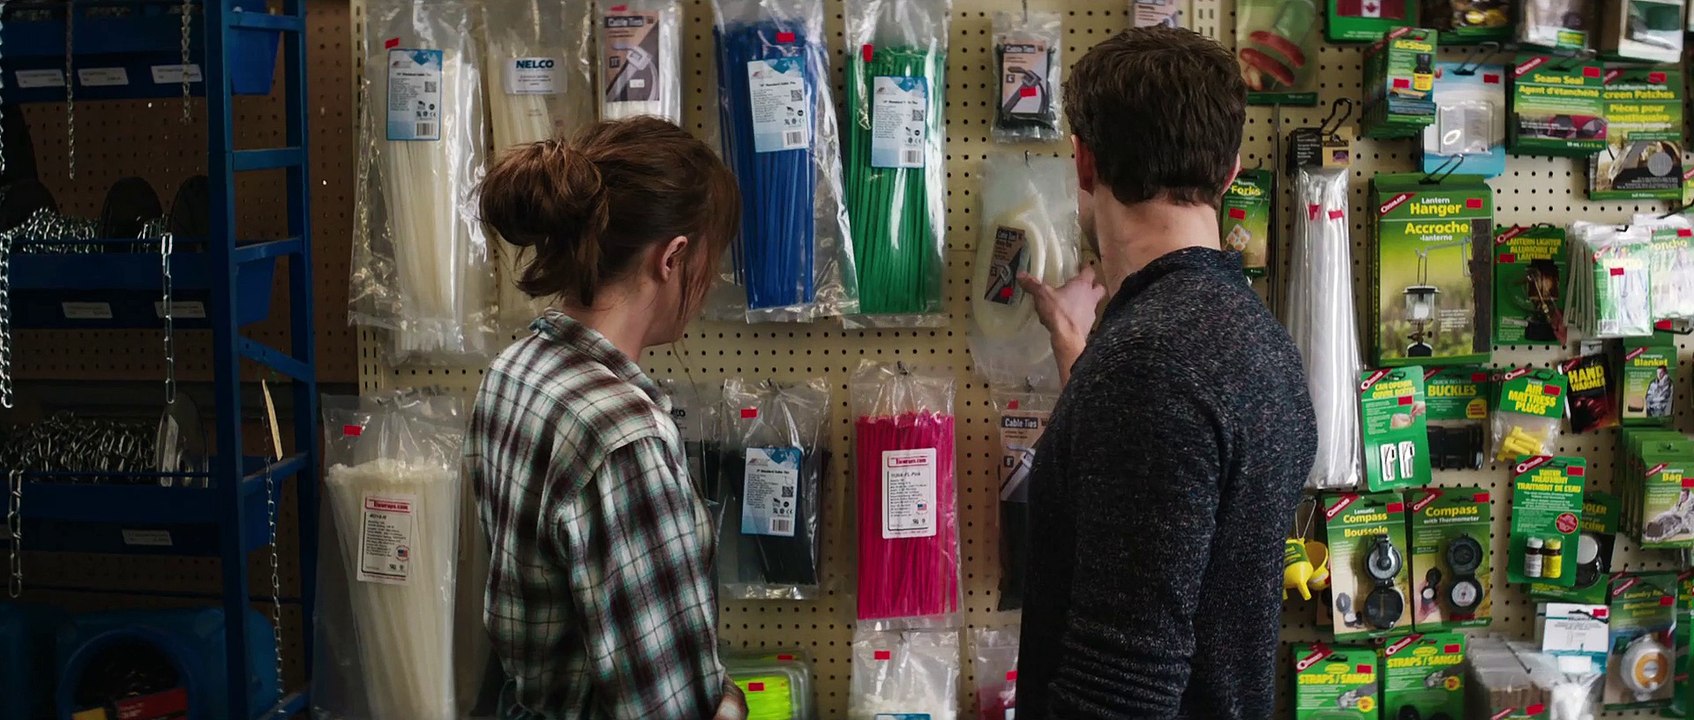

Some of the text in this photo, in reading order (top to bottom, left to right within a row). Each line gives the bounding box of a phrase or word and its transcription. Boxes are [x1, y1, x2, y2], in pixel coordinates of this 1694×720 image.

[516, 59, 554, 69] NELCO
[1533, 73, 1585, 86] Seam Seal
[1519, 86, 1546, 96] Agent
[1601, 90, 1675, 99] creen Patches
[1641, 106, 1665, 114] pour
[1231, 185, 1261, 197] Forks
[1421, 196, 1451, 204] Lantern
[1409, 203, 1462, 217] Hanger
[1404, 221, 1469, 235] Accroche
[1634, 358, 1668, 367] Blanket
[1567, 364, 1605, 384] HAND
[1374, 382, 1388, 391] CAN
[1427, 384, 1477, 397] BUCKLES
[1525, 384, 1543, 395] AIR
[1508, 390, 1557, 408] MATTRESS
[1514, 402, 1547, 415] PLUGS
[1004, 417, 1037, 428] Cable Ties
[1662, 472, 1683, 484] Bag
[1425, 505, 1478, 517] Compass
[1342, 512, 1388, 524] Compass
[1344, 525, 1388, 538] Boussole
[1387, 658, 1422, 668] STRAPS
[1299, 674, 1335, 684] STRAPS
